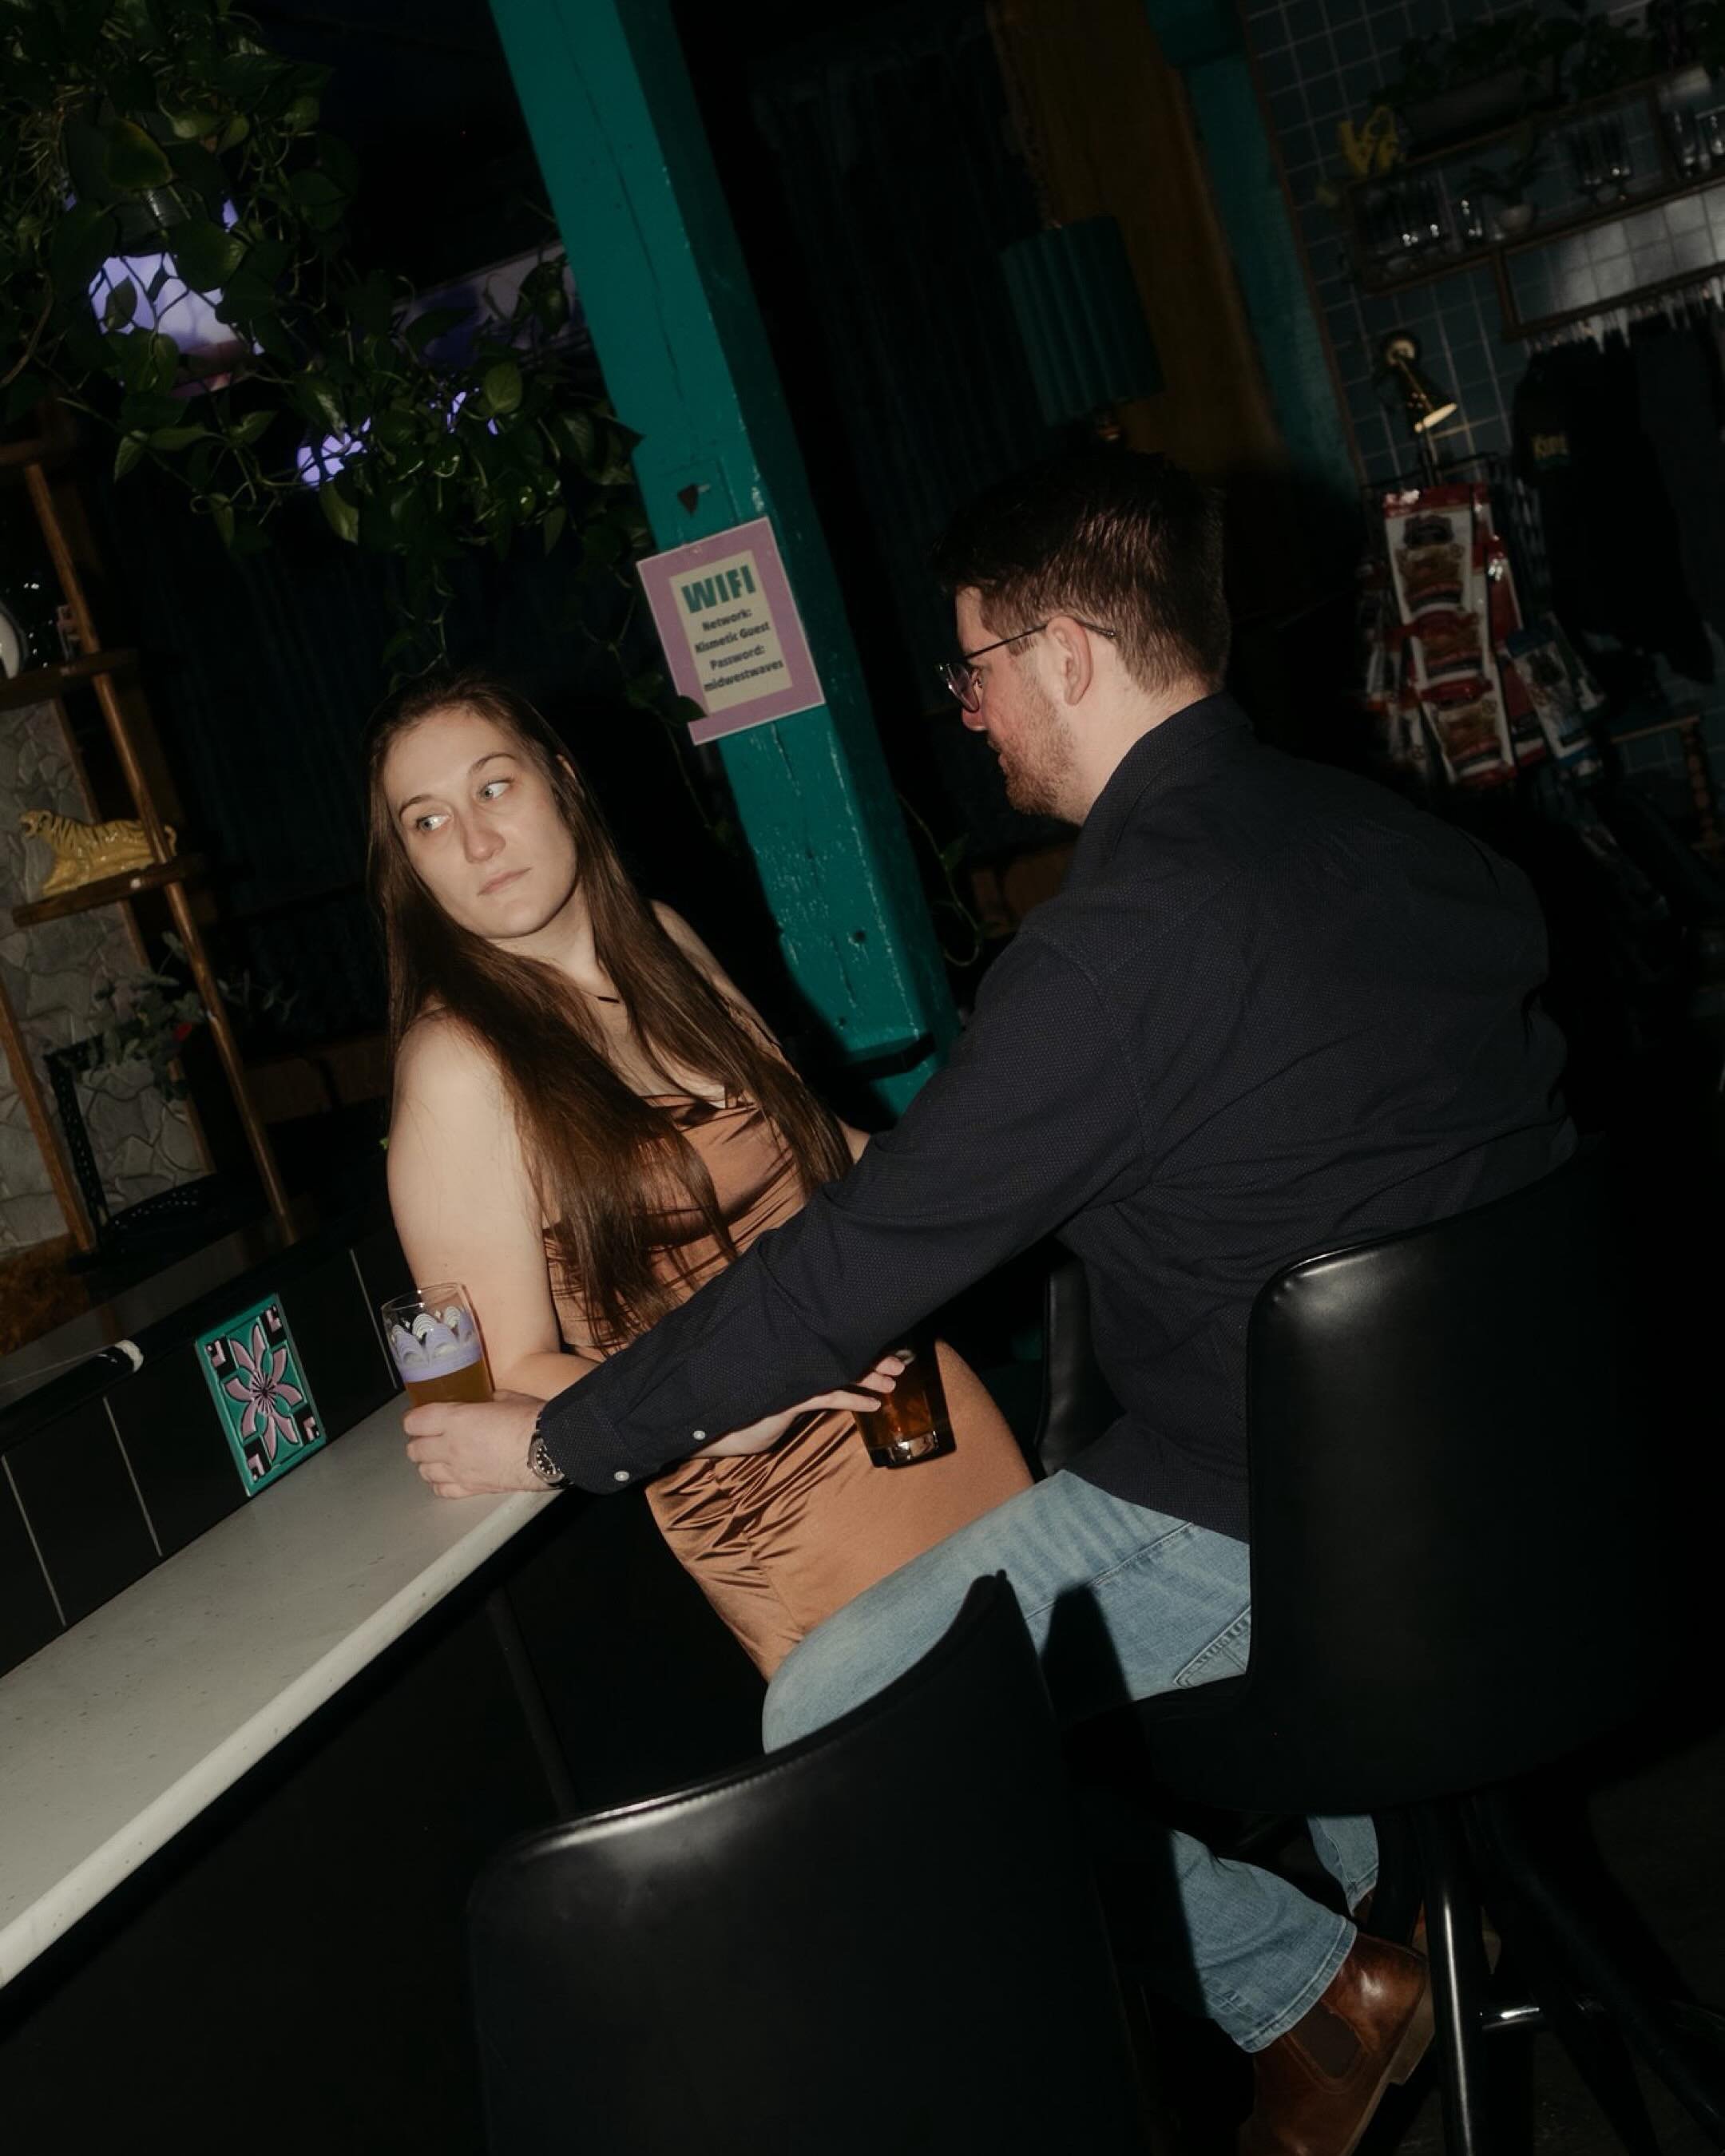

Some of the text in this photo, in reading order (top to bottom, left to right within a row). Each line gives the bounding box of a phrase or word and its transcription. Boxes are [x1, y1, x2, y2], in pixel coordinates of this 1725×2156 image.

[681, 565, 755, 613] WIFI
[702, 608, 752, 631] Network:
[695, 622, 770, 652] Kismetic Guest
[709, 645, 765, 670] Password:
[704, 660, 783, 692] midwestwaves
